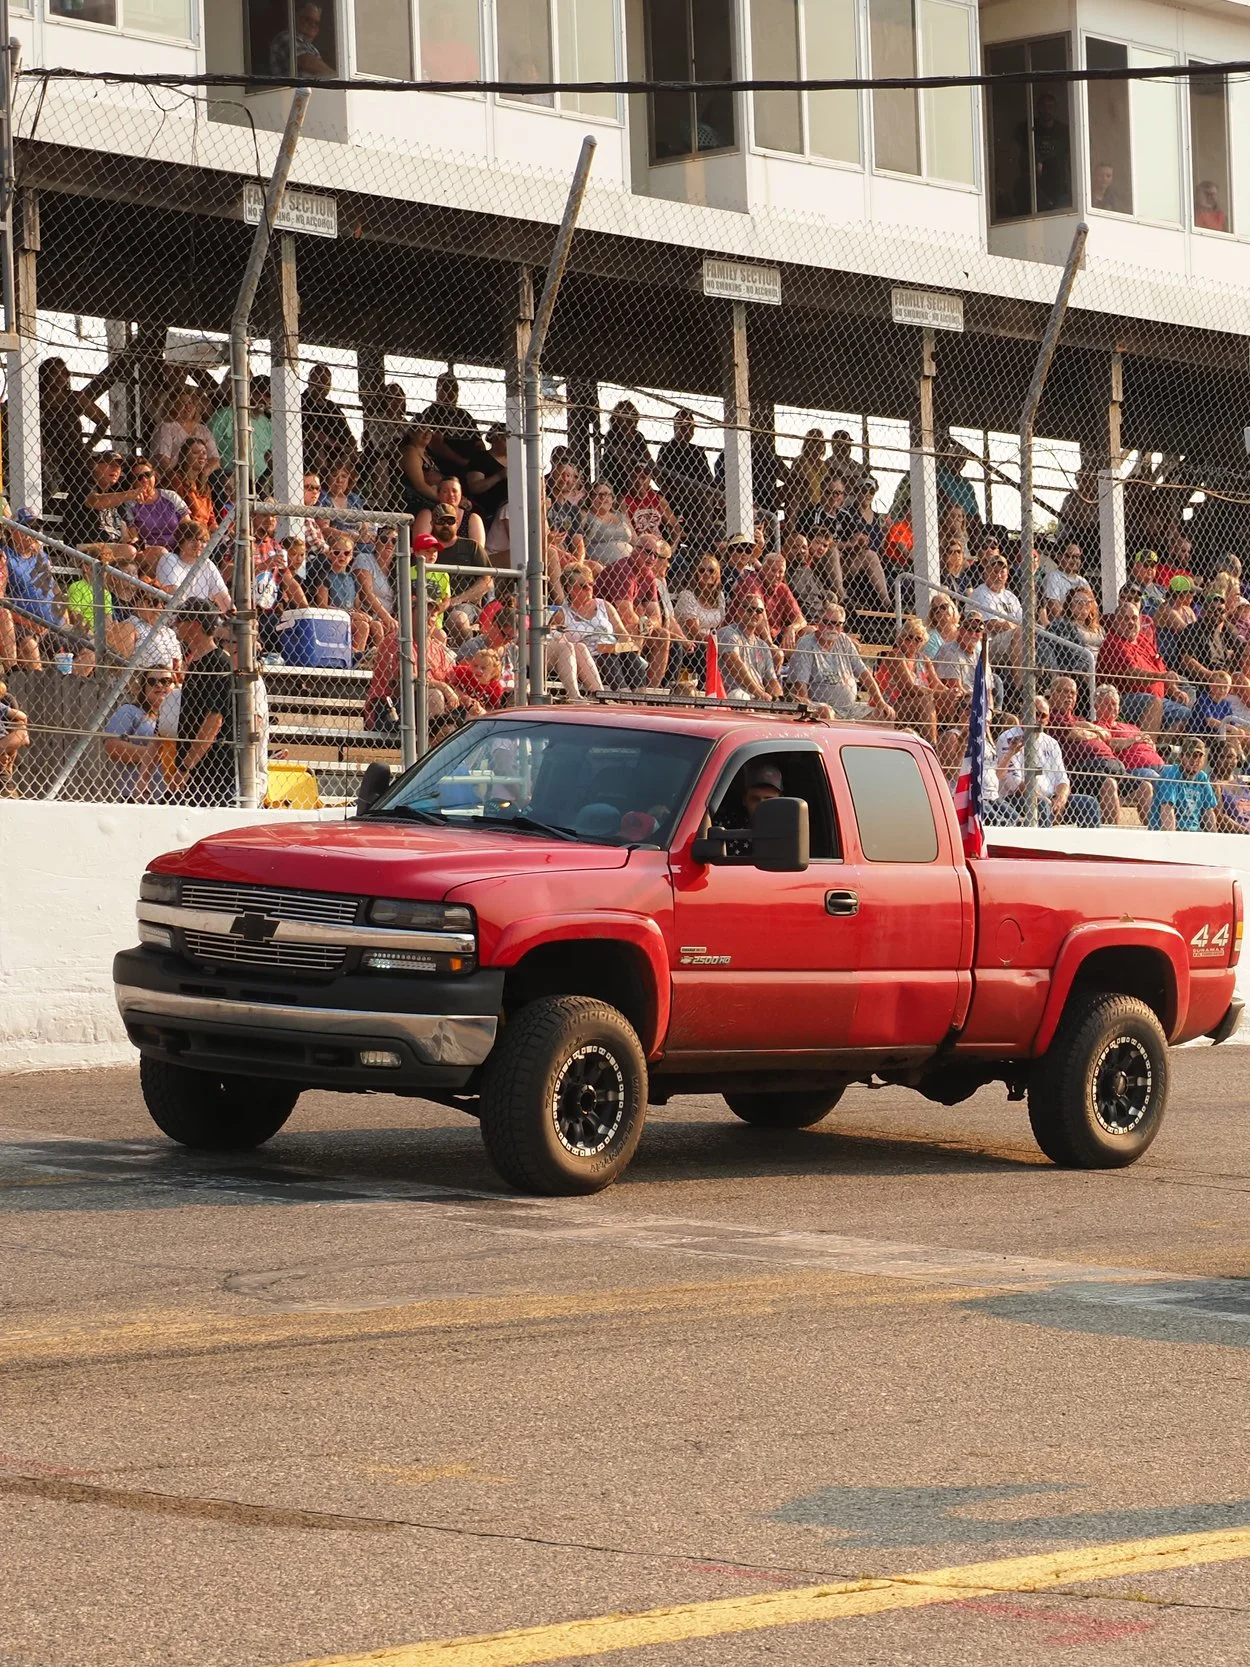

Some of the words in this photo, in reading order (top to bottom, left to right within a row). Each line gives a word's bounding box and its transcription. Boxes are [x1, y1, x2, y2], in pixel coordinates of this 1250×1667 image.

[289, 195, 334, 217] SECTION
[706, 263, 738, 281] FAMILY
[740, 267, 778, 286] SECTION
[894, 292, 925, 308] FAMILY
[927, 296, 961, 313] SECTION
